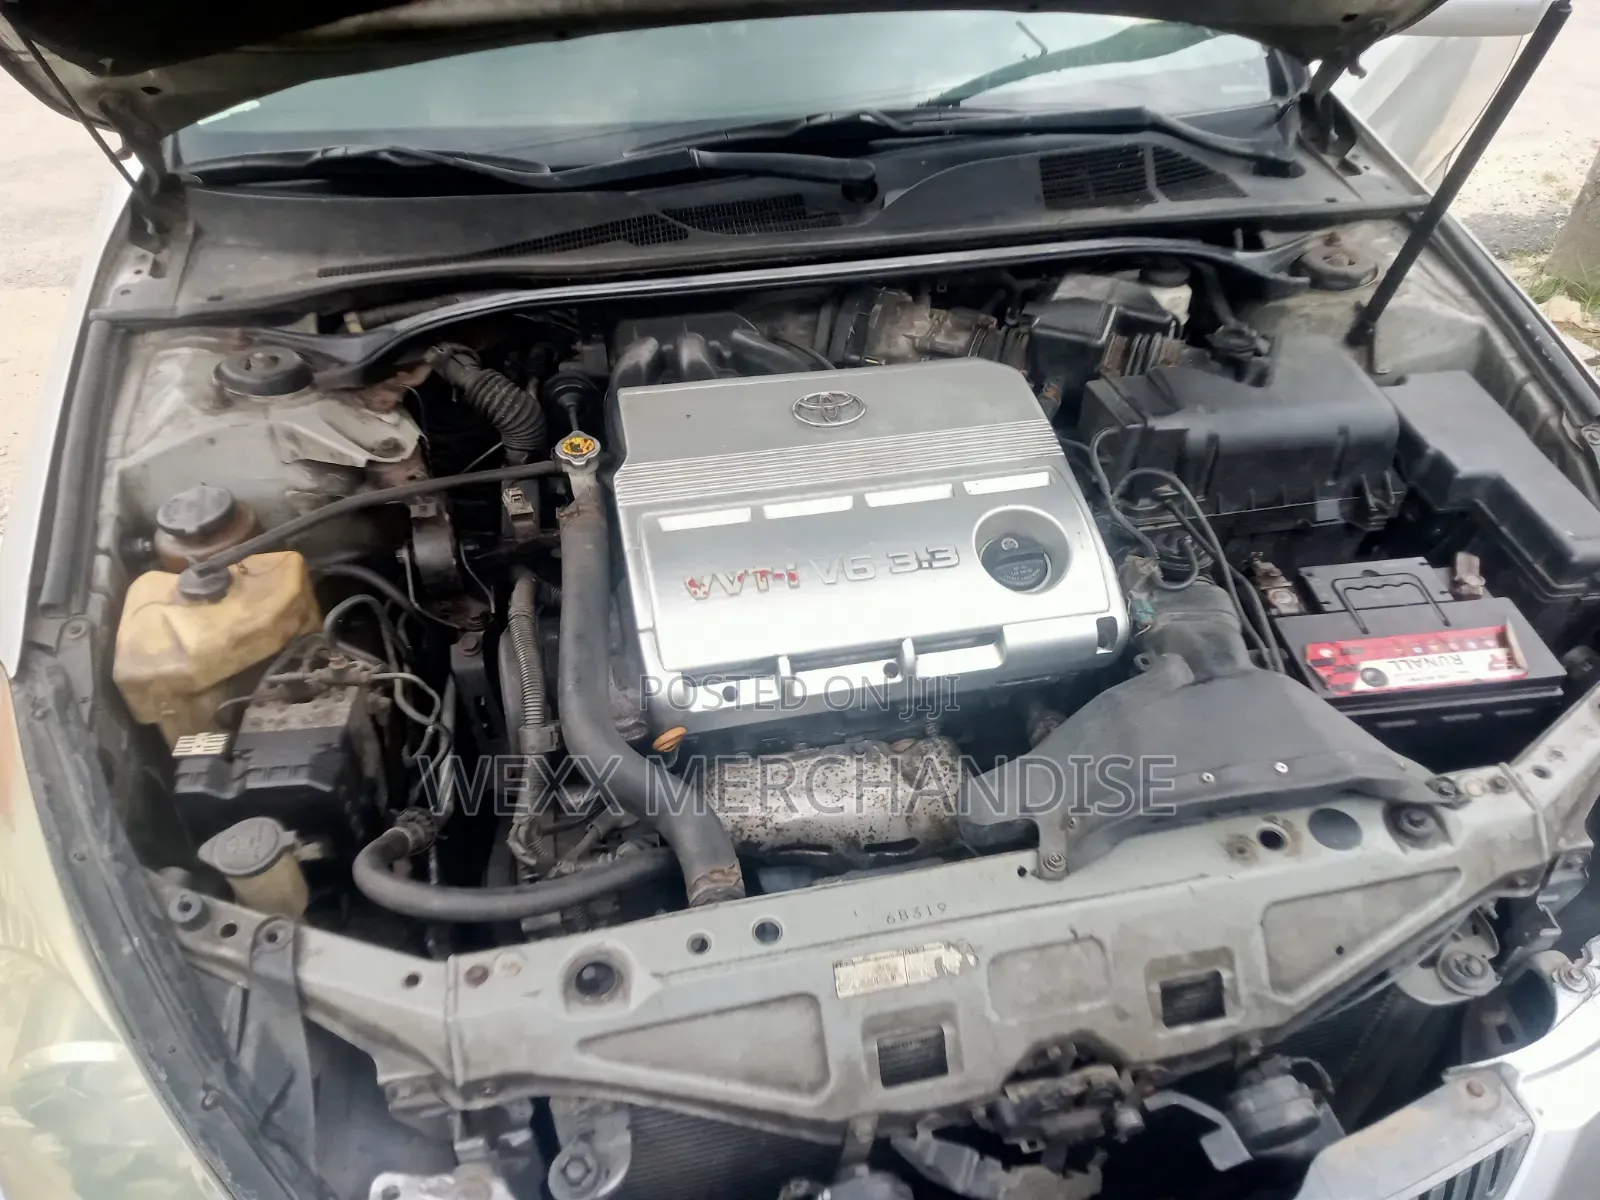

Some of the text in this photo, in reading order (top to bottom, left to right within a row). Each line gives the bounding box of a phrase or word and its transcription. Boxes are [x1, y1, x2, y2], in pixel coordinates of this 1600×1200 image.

[809, 555, 876, 585] V6
[886, 544, 960, 575] 3.3
[1387, 654, 1464, 672] RUNALL
